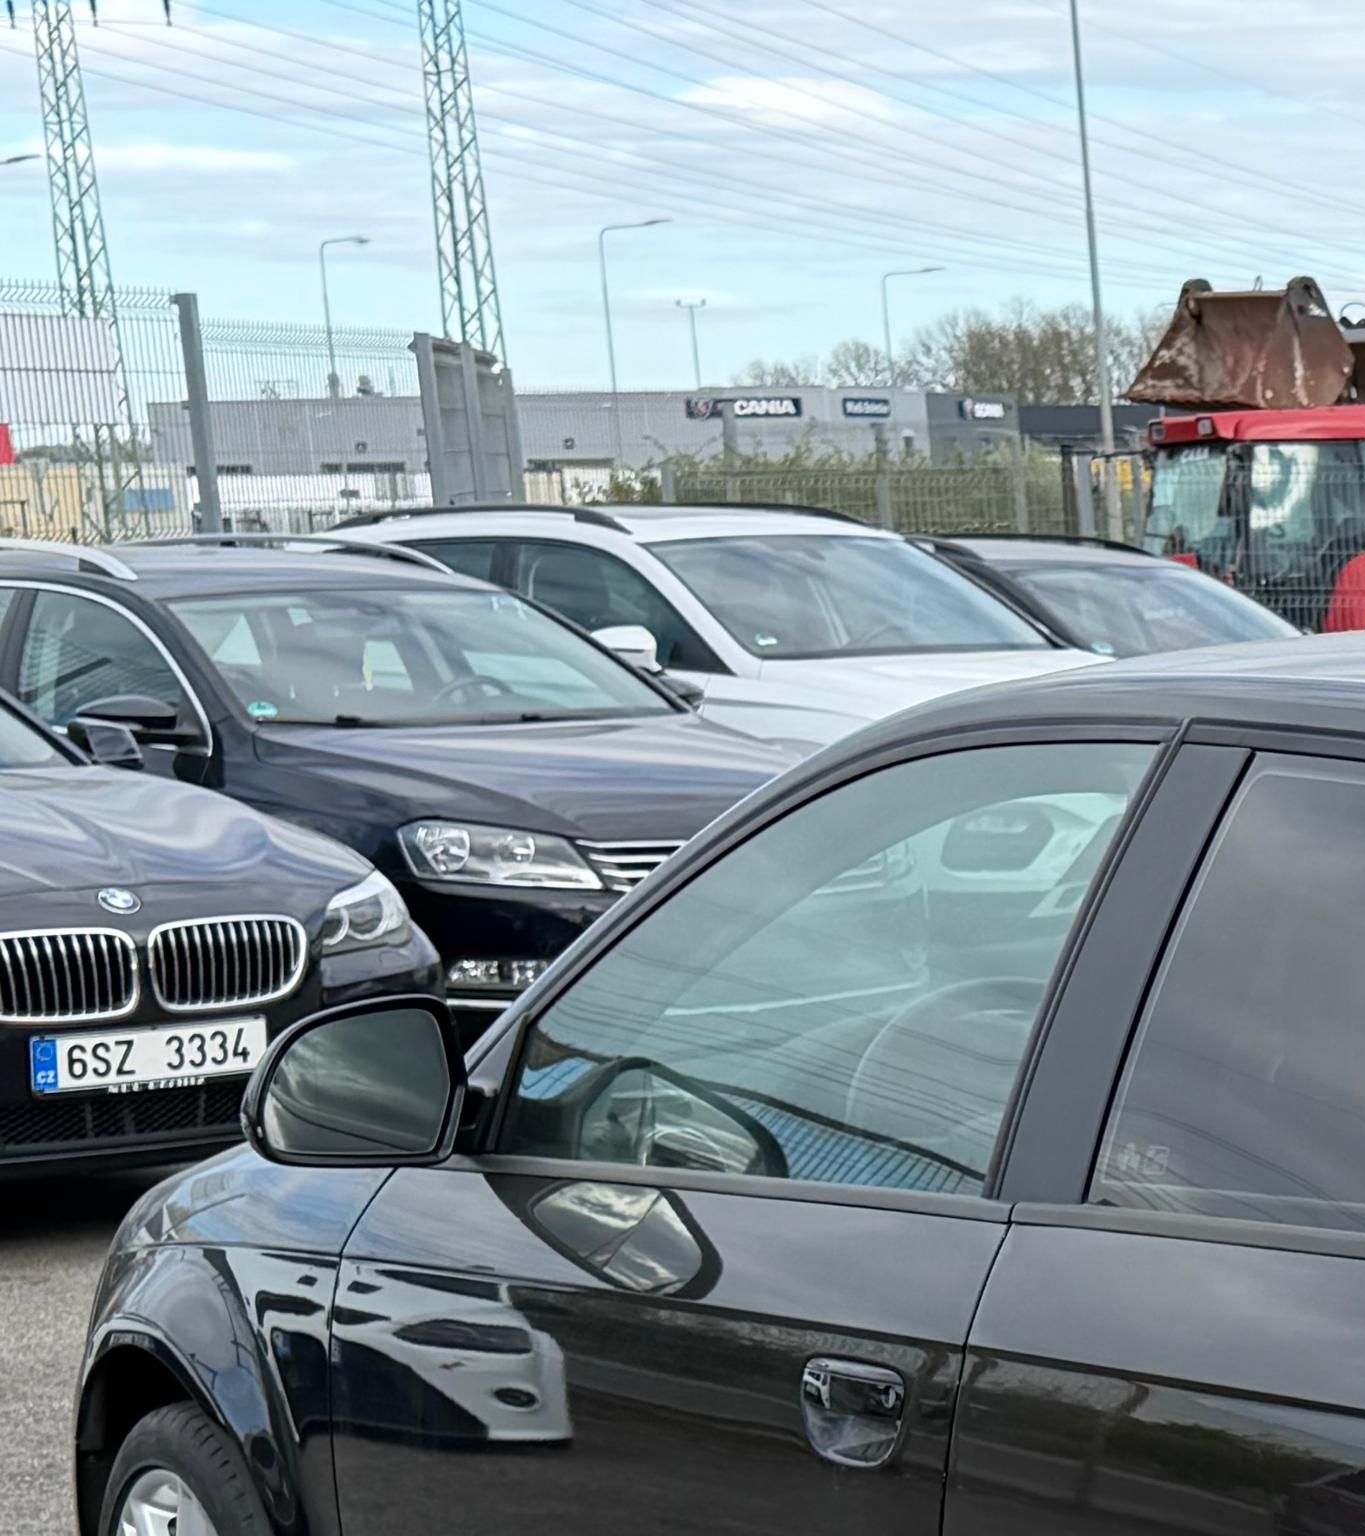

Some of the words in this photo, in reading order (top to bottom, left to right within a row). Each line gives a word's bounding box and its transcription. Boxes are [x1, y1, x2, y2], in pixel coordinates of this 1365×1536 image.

[733, 399, 797, 416] CANIA
[67, 1039, 136, 1079] 6SZ
[165, 1028, 250, 1070] 3334
[36, 1070, 56, 1084] CZ
